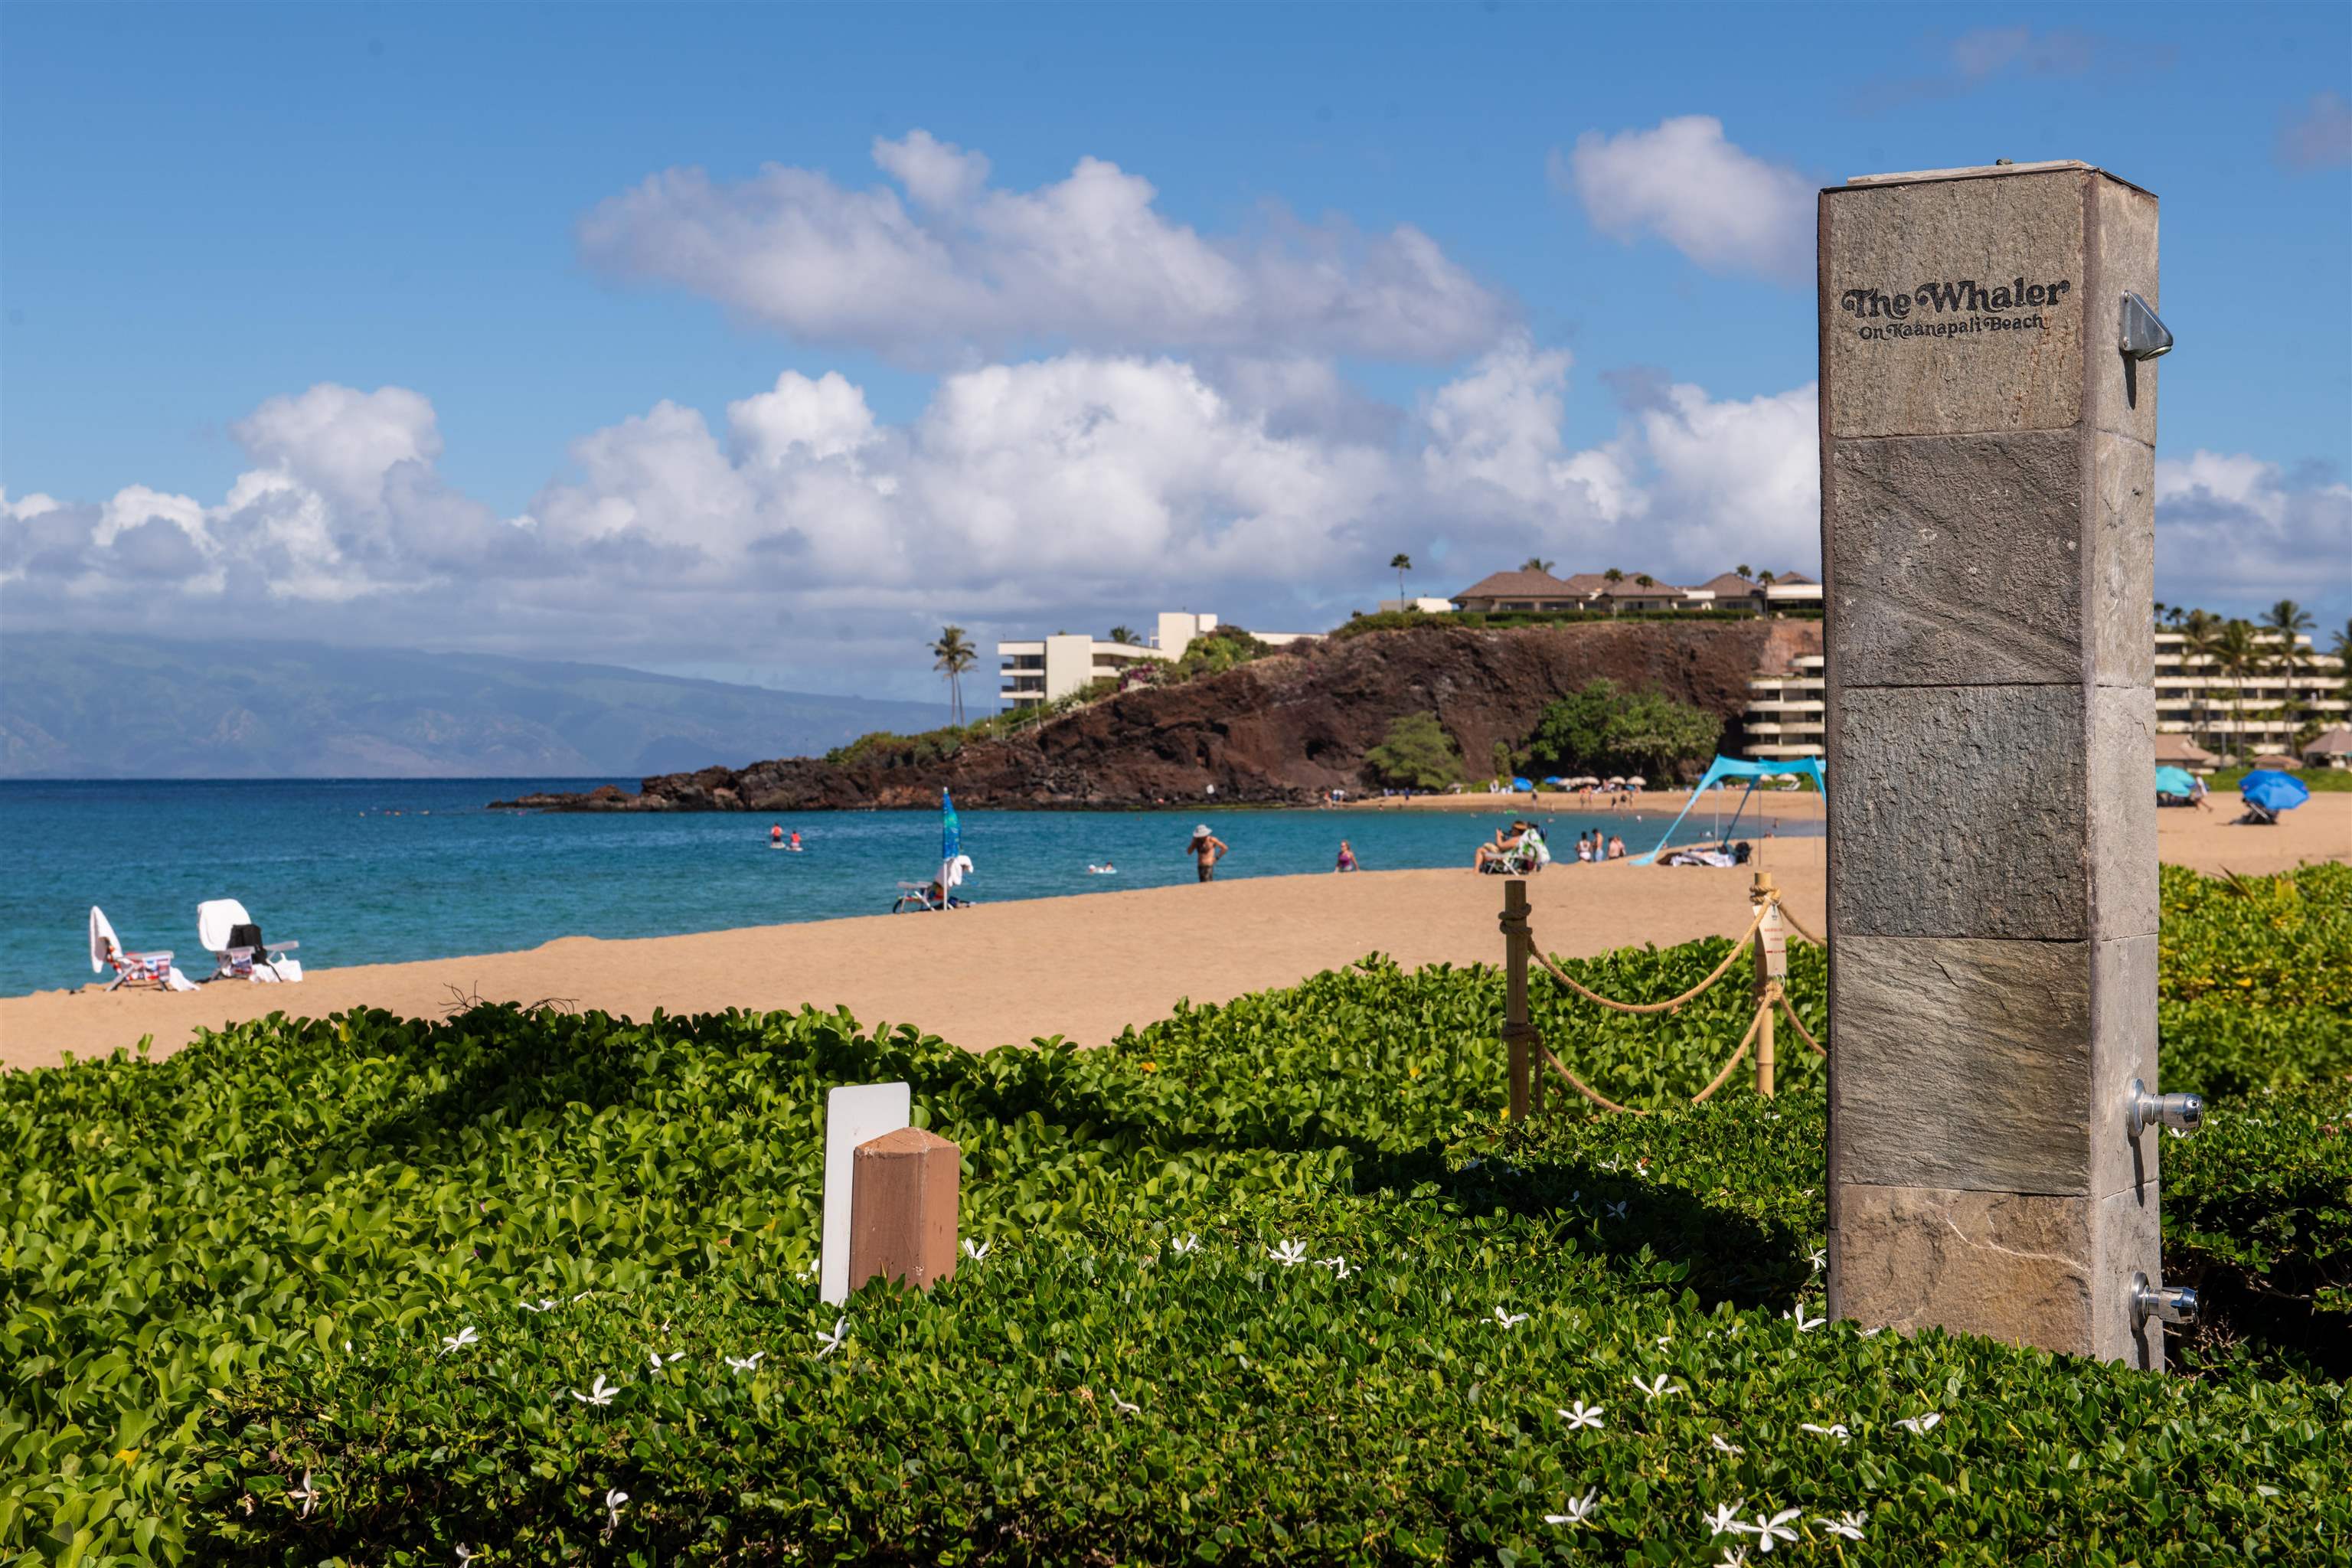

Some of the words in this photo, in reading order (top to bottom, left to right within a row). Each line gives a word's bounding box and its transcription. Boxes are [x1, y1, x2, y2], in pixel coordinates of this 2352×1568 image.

[1841, 287, 1912, 320] The
[1915, 276, 2071, 313] Whaler
[1859, 325, 1889, 341] On
[1984, 313, 2050, 332] Beach
